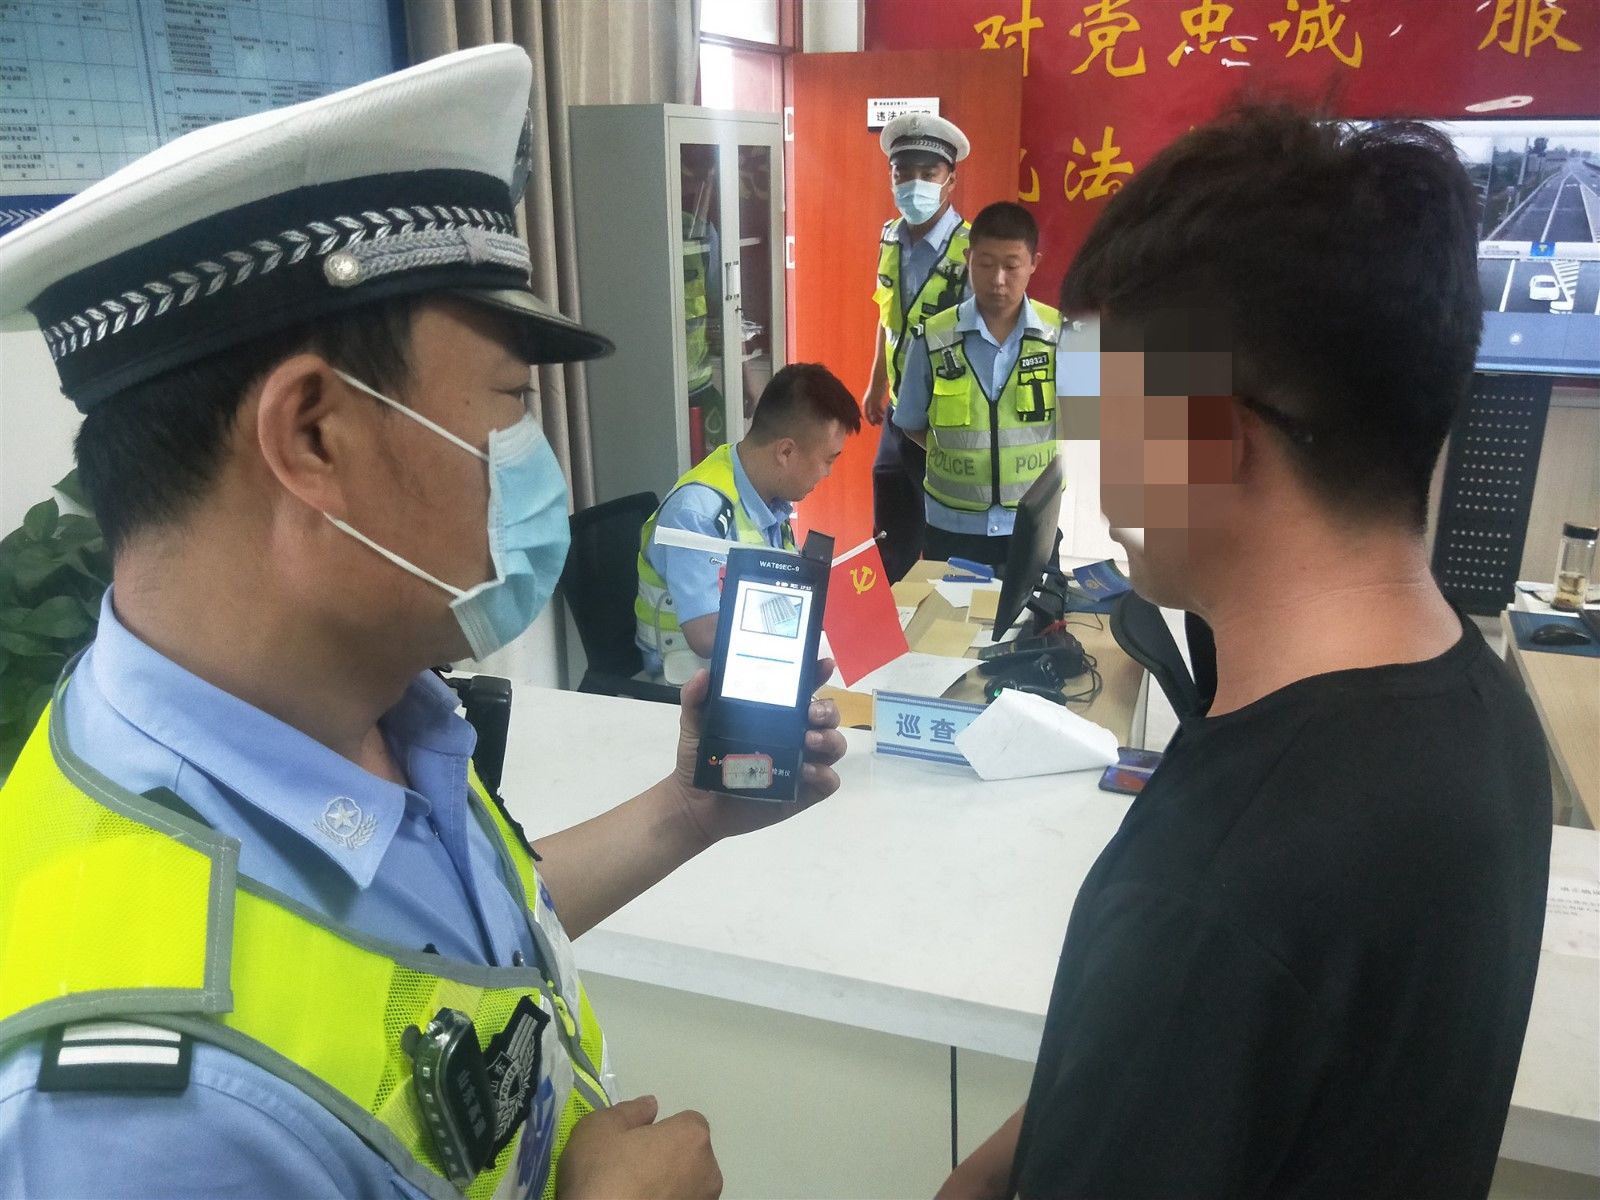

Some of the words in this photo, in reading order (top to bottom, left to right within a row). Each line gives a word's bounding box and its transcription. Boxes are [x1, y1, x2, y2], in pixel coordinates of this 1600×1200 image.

[973, 0, 1362, 77] 对党忠诚
[927, 446, 976, 476] POLICE
